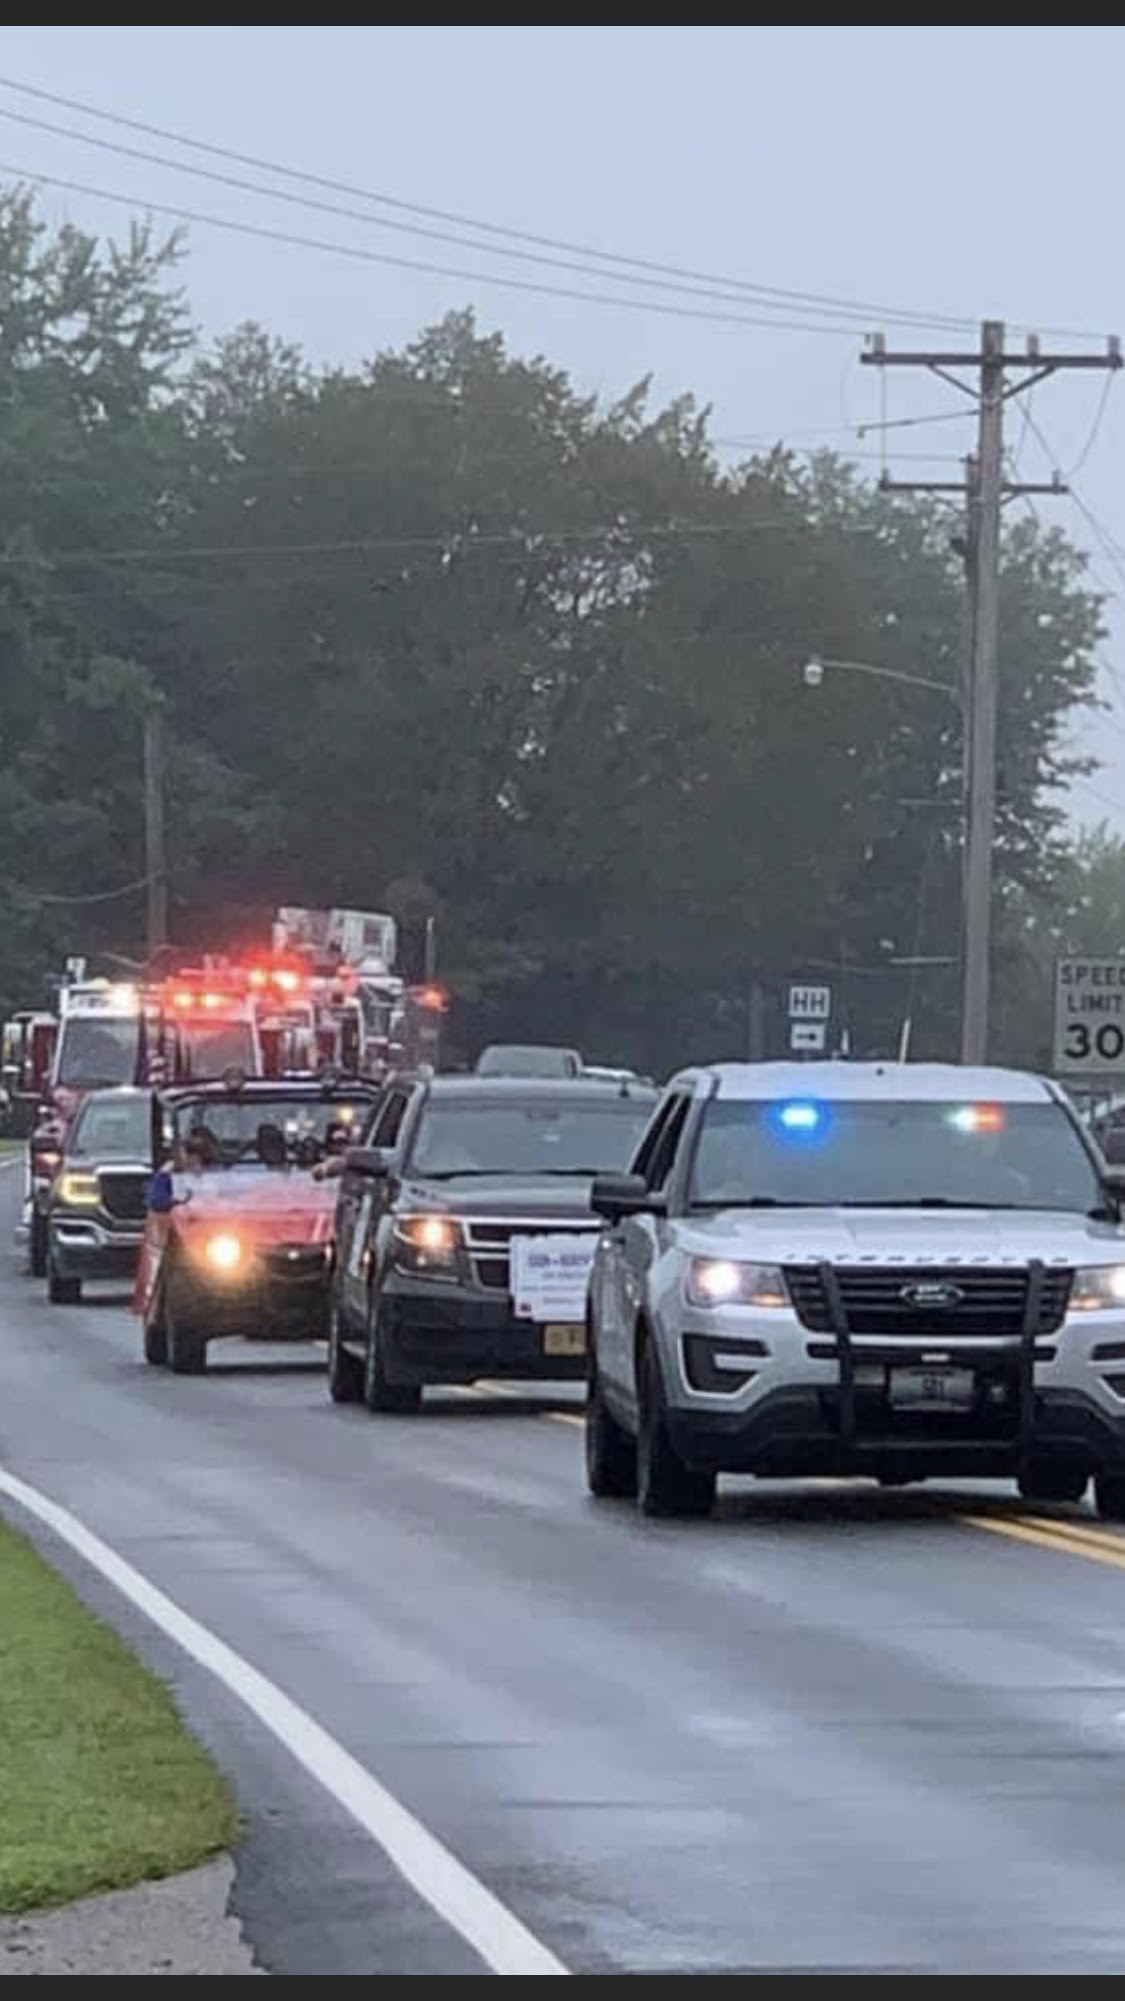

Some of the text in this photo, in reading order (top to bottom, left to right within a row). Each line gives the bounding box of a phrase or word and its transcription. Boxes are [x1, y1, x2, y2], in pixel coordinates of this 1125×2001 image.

[793, 991, 825, 1011] HH
[1067, 993, 1122, 1013] LIMIT
[1064, 1023, 1124, 1059] 30
